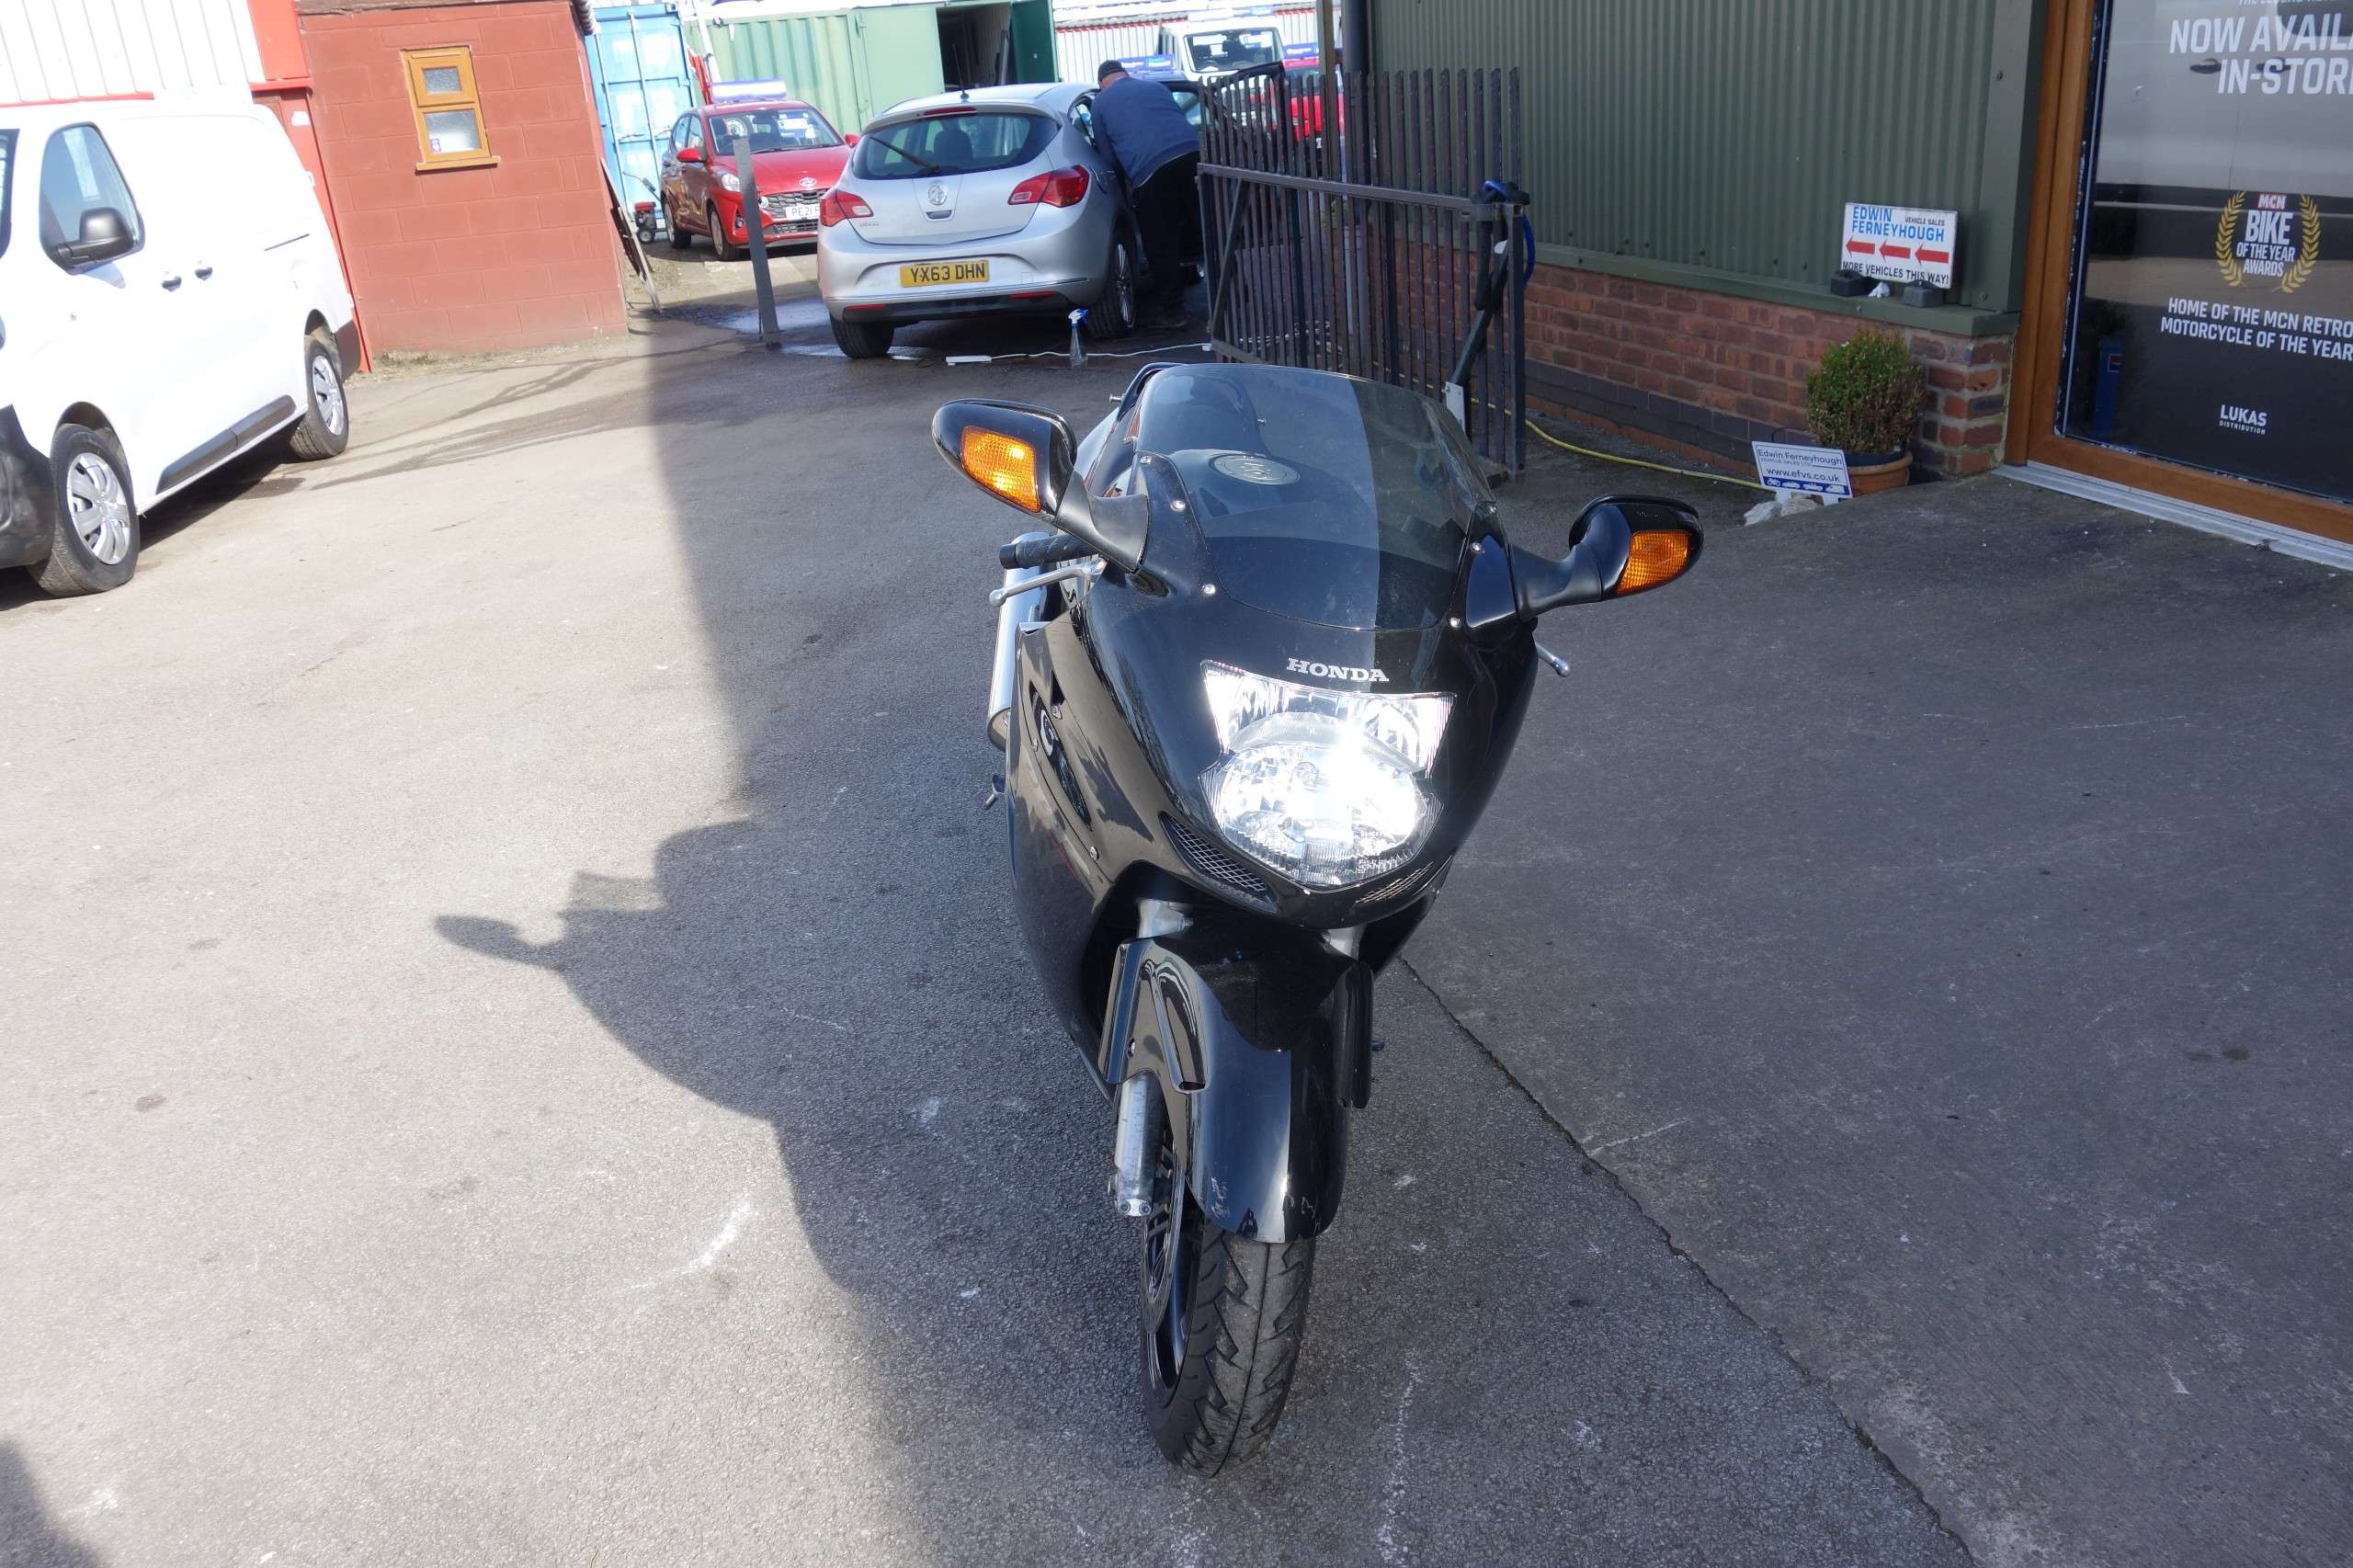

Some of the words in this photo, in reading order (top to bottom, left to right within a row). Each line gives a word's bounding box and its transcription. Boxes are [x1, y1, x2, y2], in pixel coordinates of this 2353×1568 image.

[2169, 17, 2245, 53] NOW
[2218, 57, 2353, 95] IN-STOR
[2257, 194, 2287, 210] MCN
[1853, 205, 1892, 222] EDWIN
[1904, 216, 1927, 224] VEHICLE
[1852, 220, 1944, 242] FERNEYHOUGH
[2245, 210, 2293, 245] BIKE
[2236, 242, 2249, 257] OF
[2250, 243, 2268, 259] THE
[2269, 245, 2295, 262] YEAR
[910, 266, 950, 283] YX63
[955, 263, 985, 280] DHN
[1842, 261, 1864, 272] MORE
[1866, 264, 1904, 278] VEHICLES
[1905, 269, 1926, 281] THIS
[1927, 272, 1949, 285] WAY!
[2243, 258, 2285, 278] AWARDS
[2168, 297, 2208, 317] HOME
[2211, 303, 2230, 320] OF
[2233, 306, 2260, 325] THE
[2264, 310, 2299, 331] MCN
[2302, 315, 2353, 339] RETRO
[2161, 316, 2253, 346] MOTORCYCLE
[2256, 332, 2276, 348] OF
[2279, 334, 2308, 354] THE
[2312, 338, 2353, 361] YEAR
[2220, 404, 2268, 426] LUKAS
[1757, 449, 1783, 458] Edwin
[1785, 452, 1842, 466] Ferneyhough
[1287, 657, 1390, 682] HONDA
